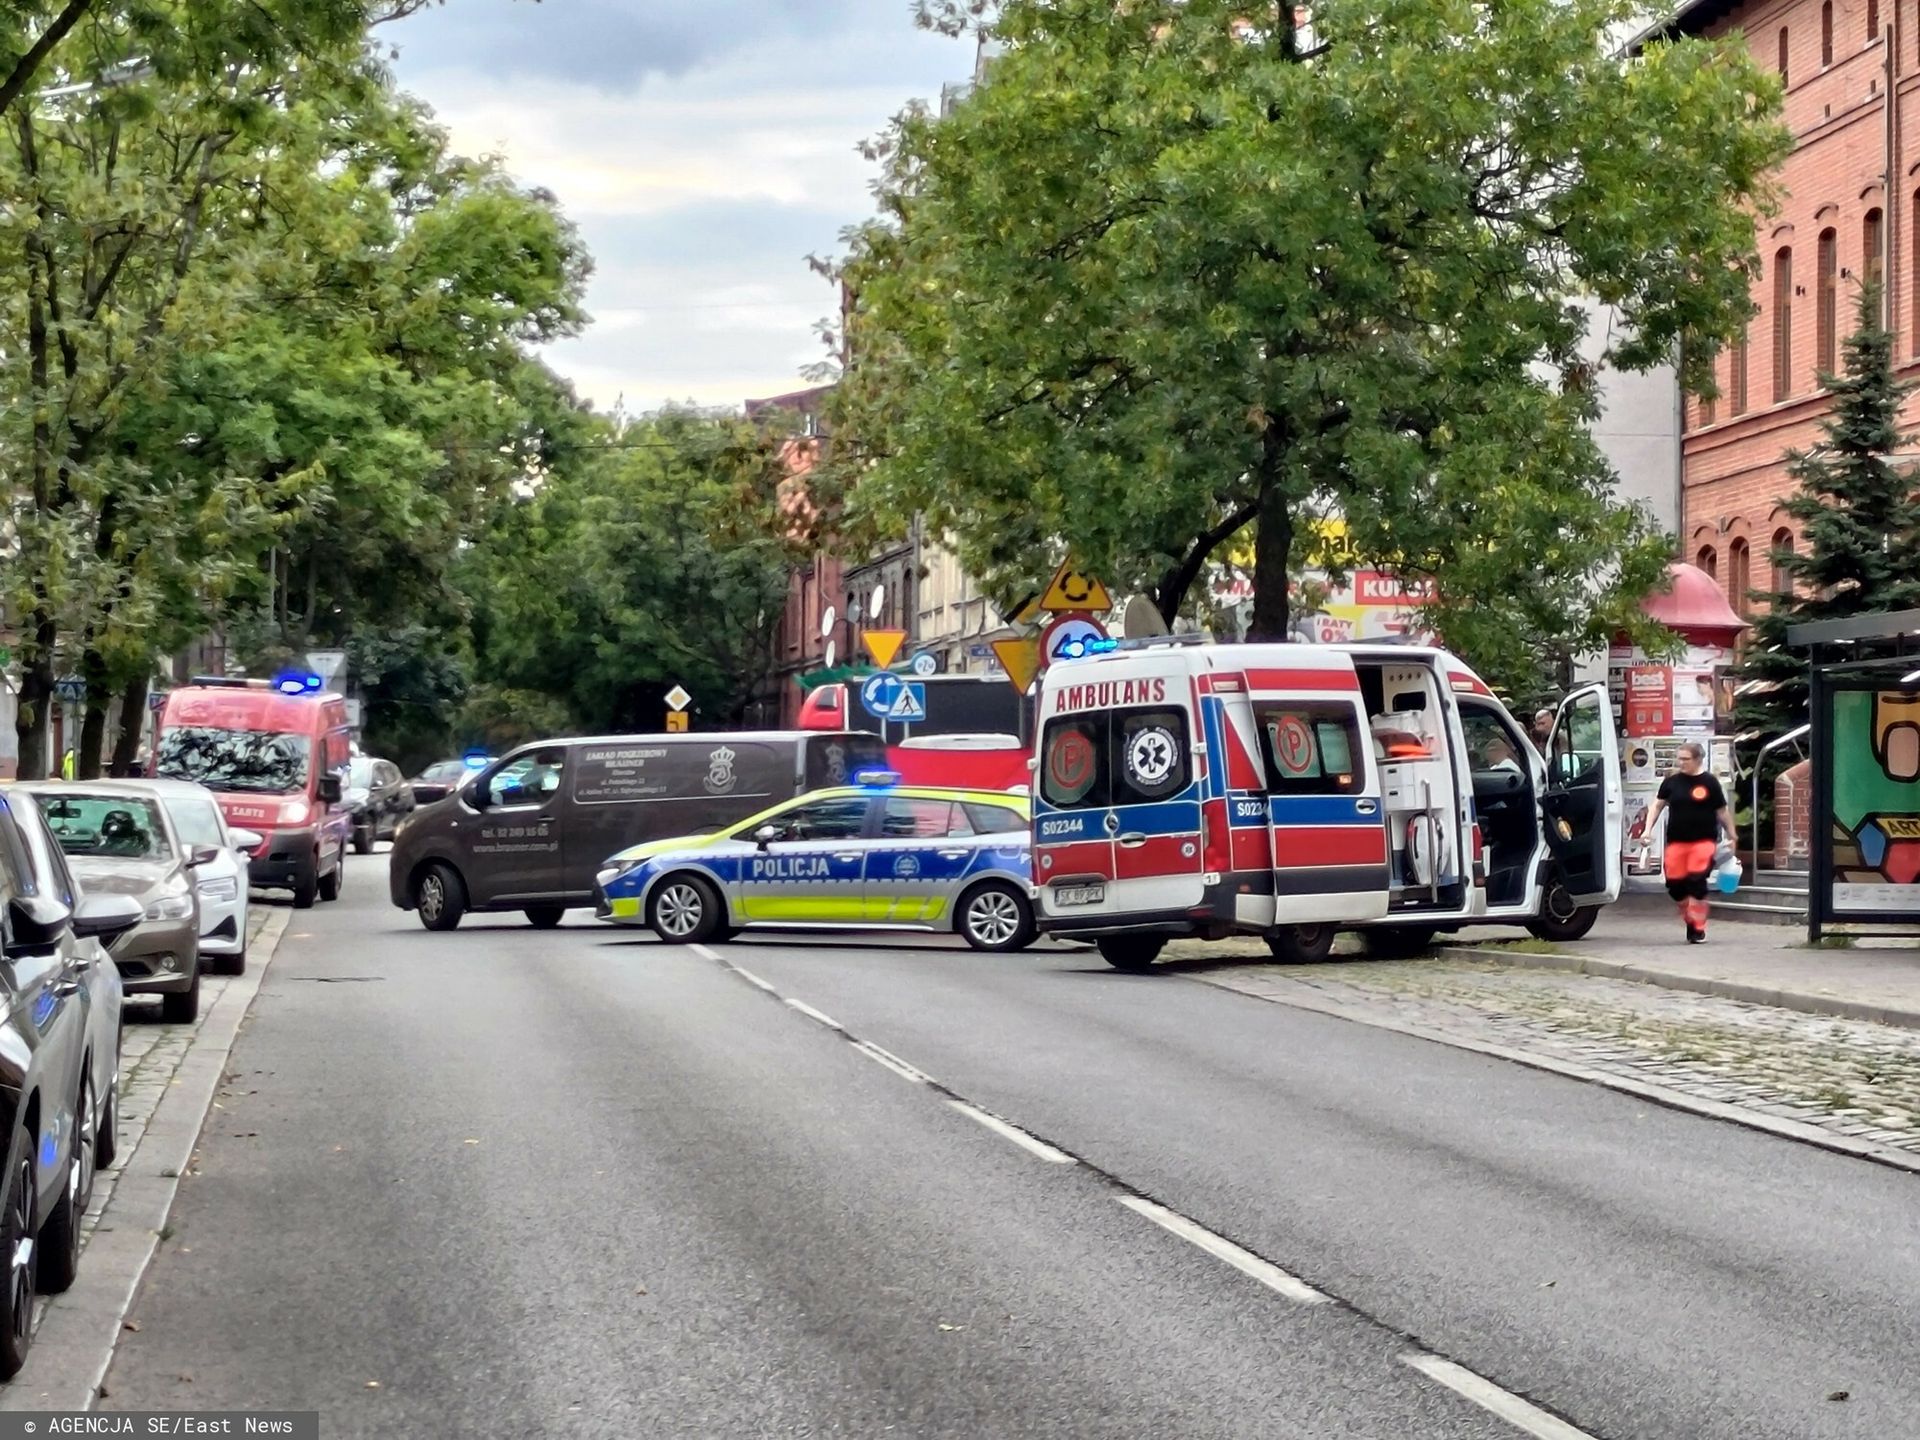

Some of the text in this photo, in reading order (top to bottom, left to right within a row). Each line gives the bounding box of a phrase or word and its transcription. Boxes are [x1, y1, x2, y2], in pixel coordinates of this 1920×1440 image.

[1322, 618, 1353, 629] RATY
[1321, 628, 1348, 643] 0%
[1056, 678, 1166, 713] AMBULANS
[1042, 818, 1083, 836] S02344
[753, 858, 830, 877] POLICJA
